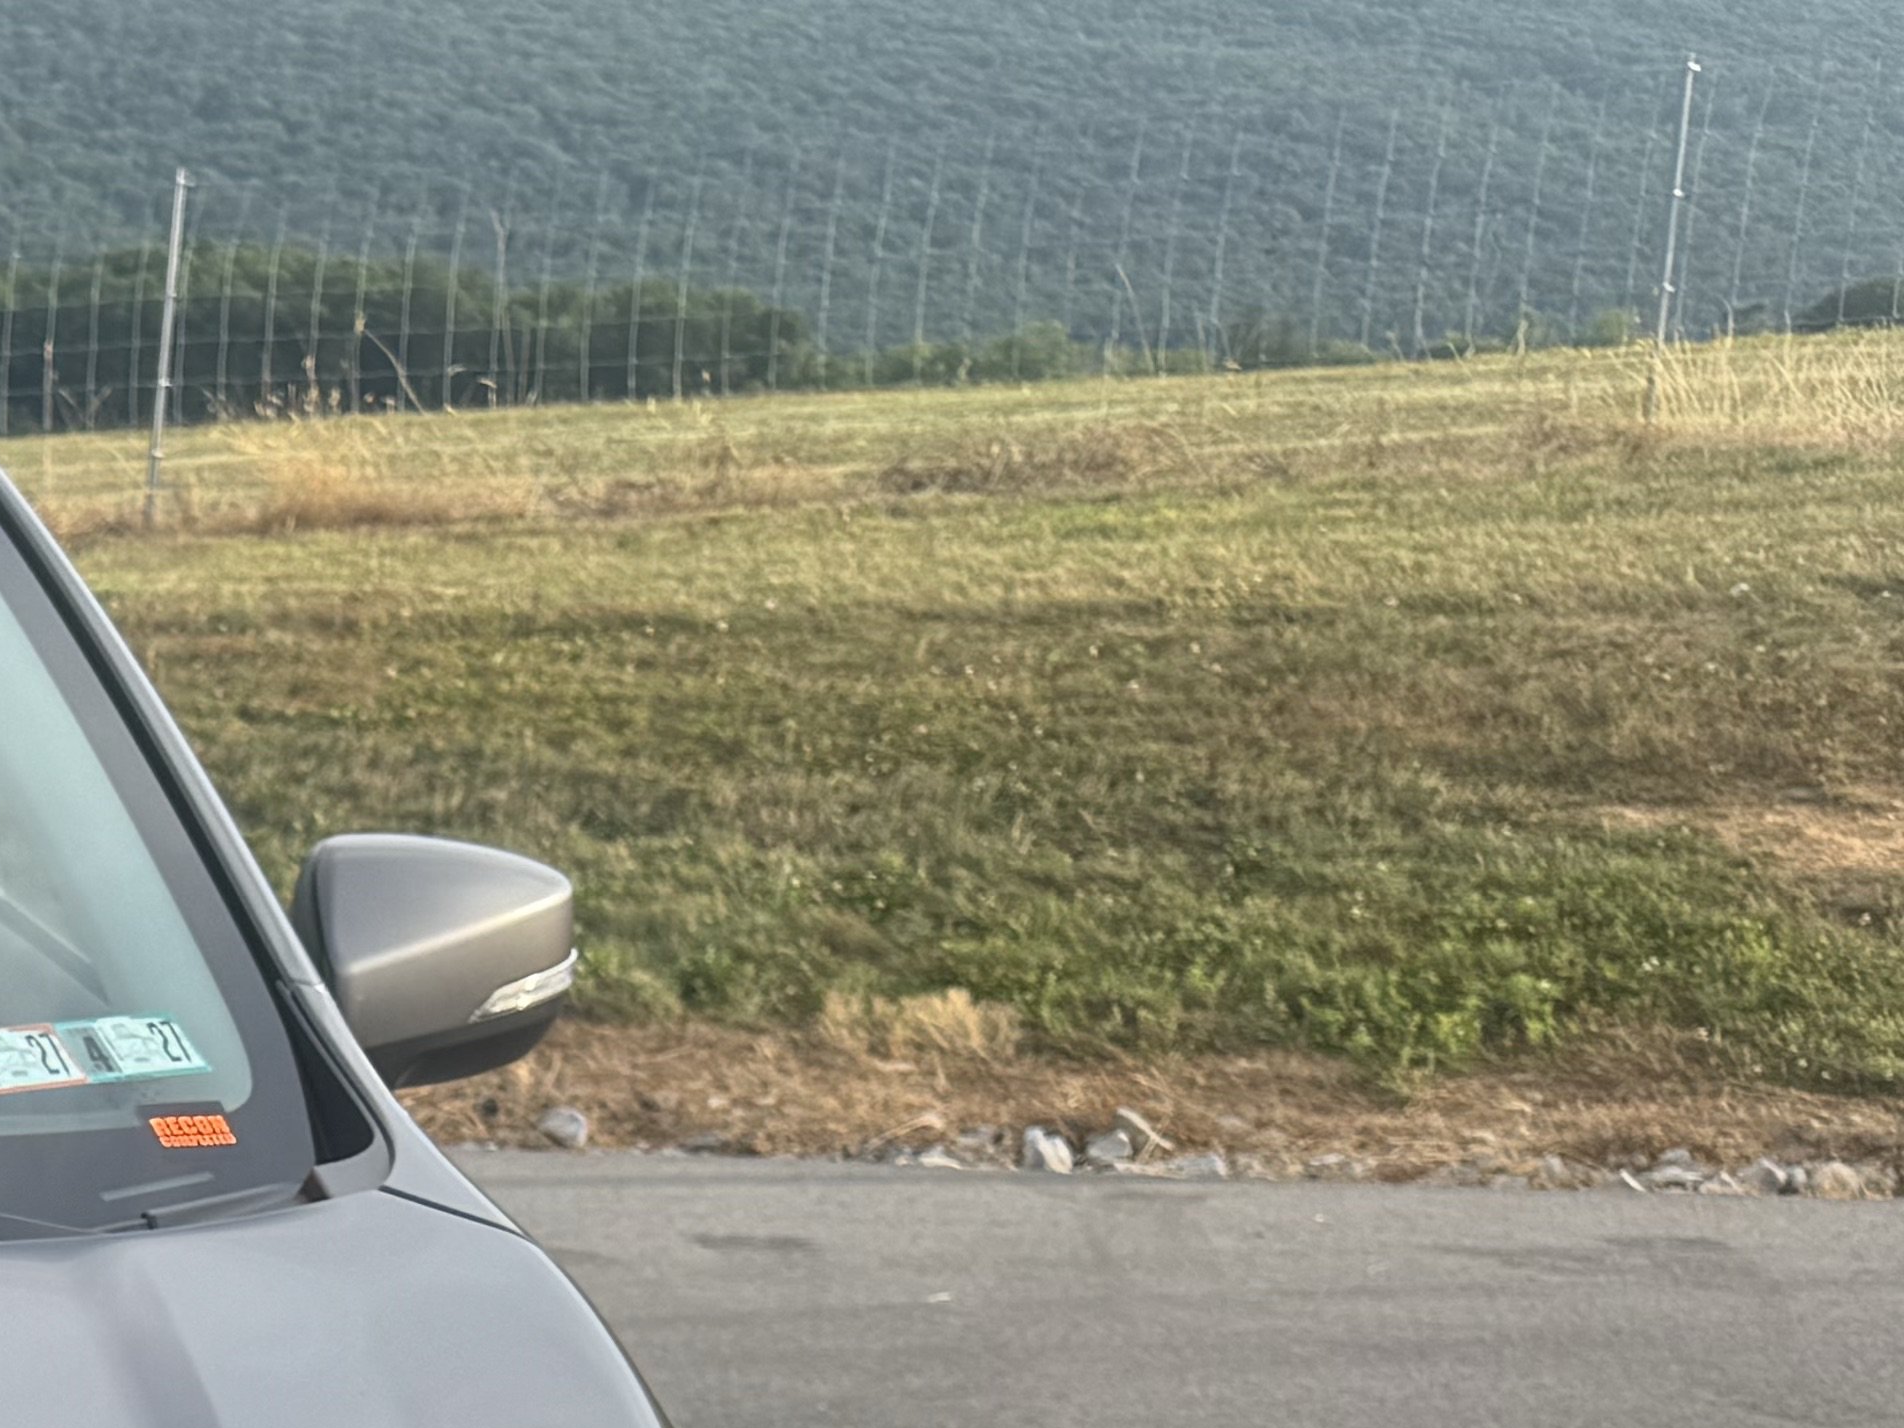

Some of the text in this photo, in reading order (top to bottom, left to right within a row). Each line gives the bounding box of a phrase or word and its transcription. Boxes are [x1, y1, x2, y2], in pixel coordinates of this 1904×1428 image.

[25, 1033, 71, 1077] 27
[146, 1020, 192, 1063] 27
[149, 1115, 230, 1137] RECON
